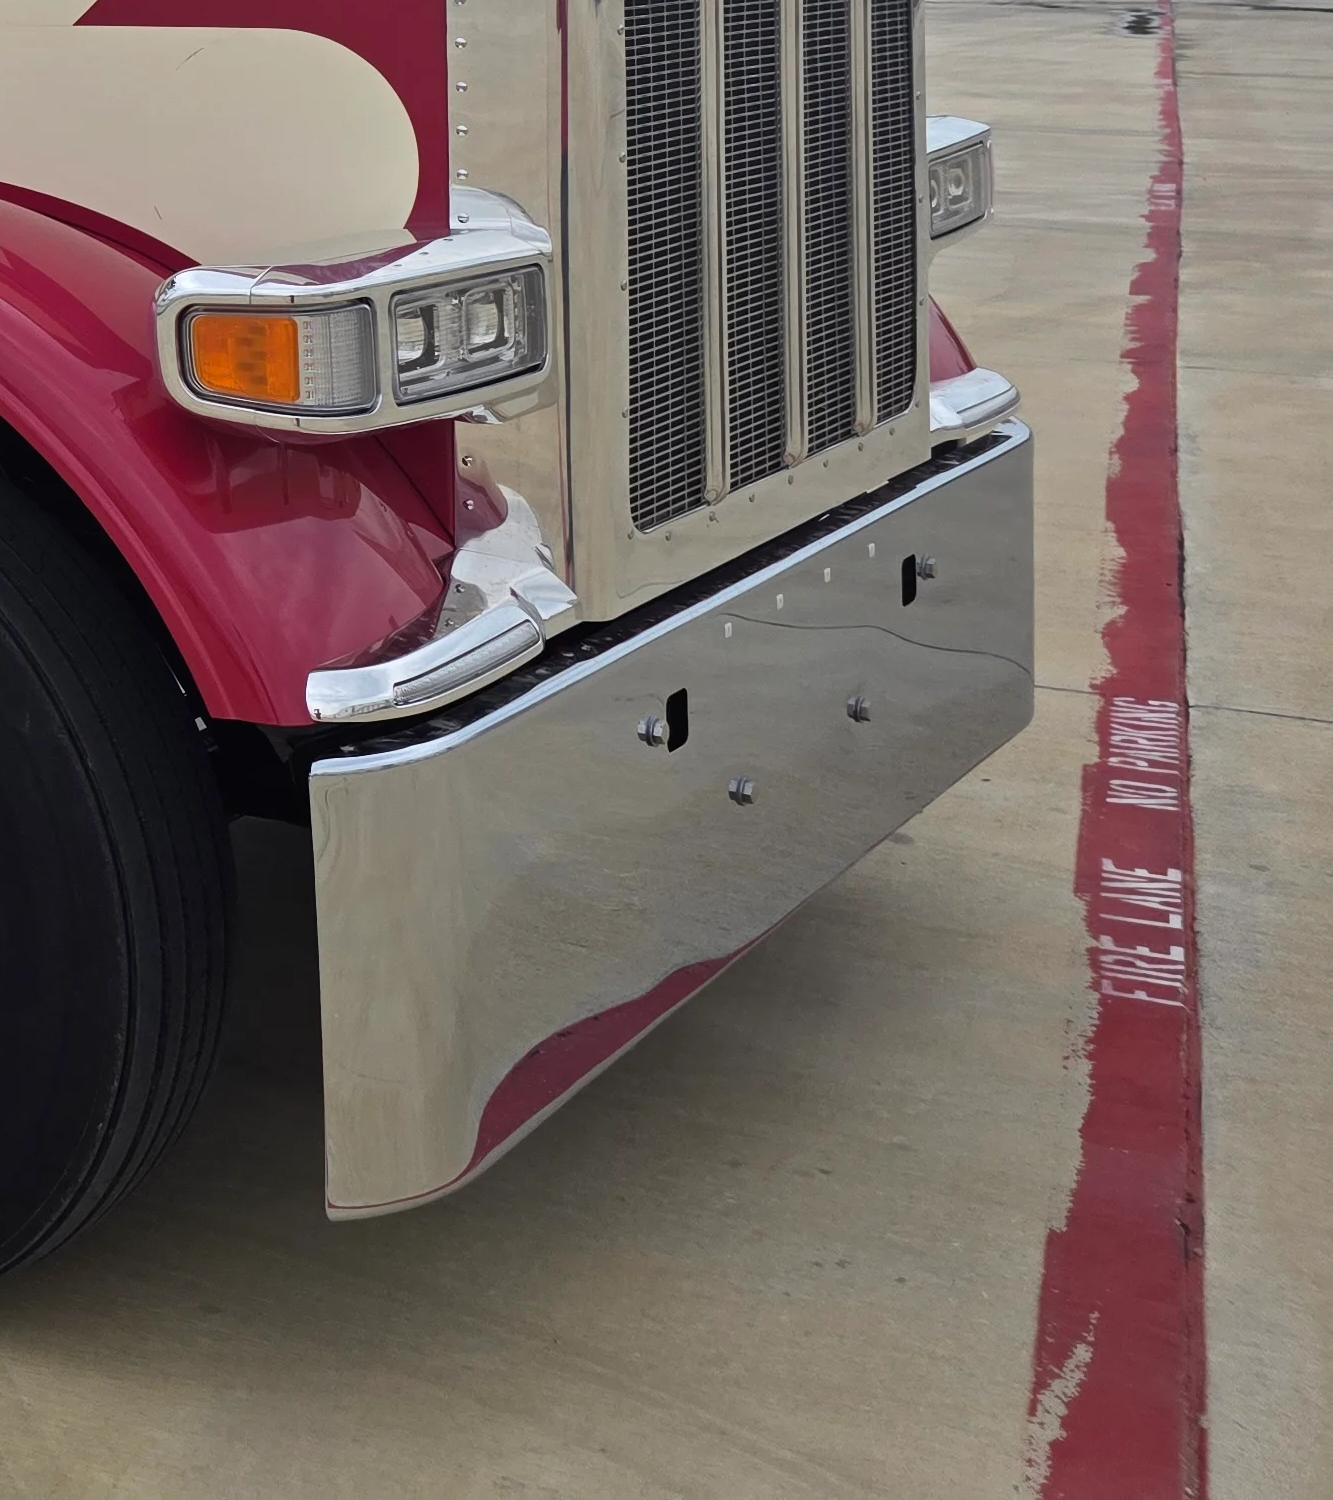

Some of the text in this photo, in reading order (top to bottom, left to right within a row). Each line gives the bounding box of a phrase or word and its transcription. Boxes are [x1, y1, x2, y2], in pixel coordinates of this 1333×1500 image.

[1099, 697, 1185, 1007] FIRE LANE NO PARKING
